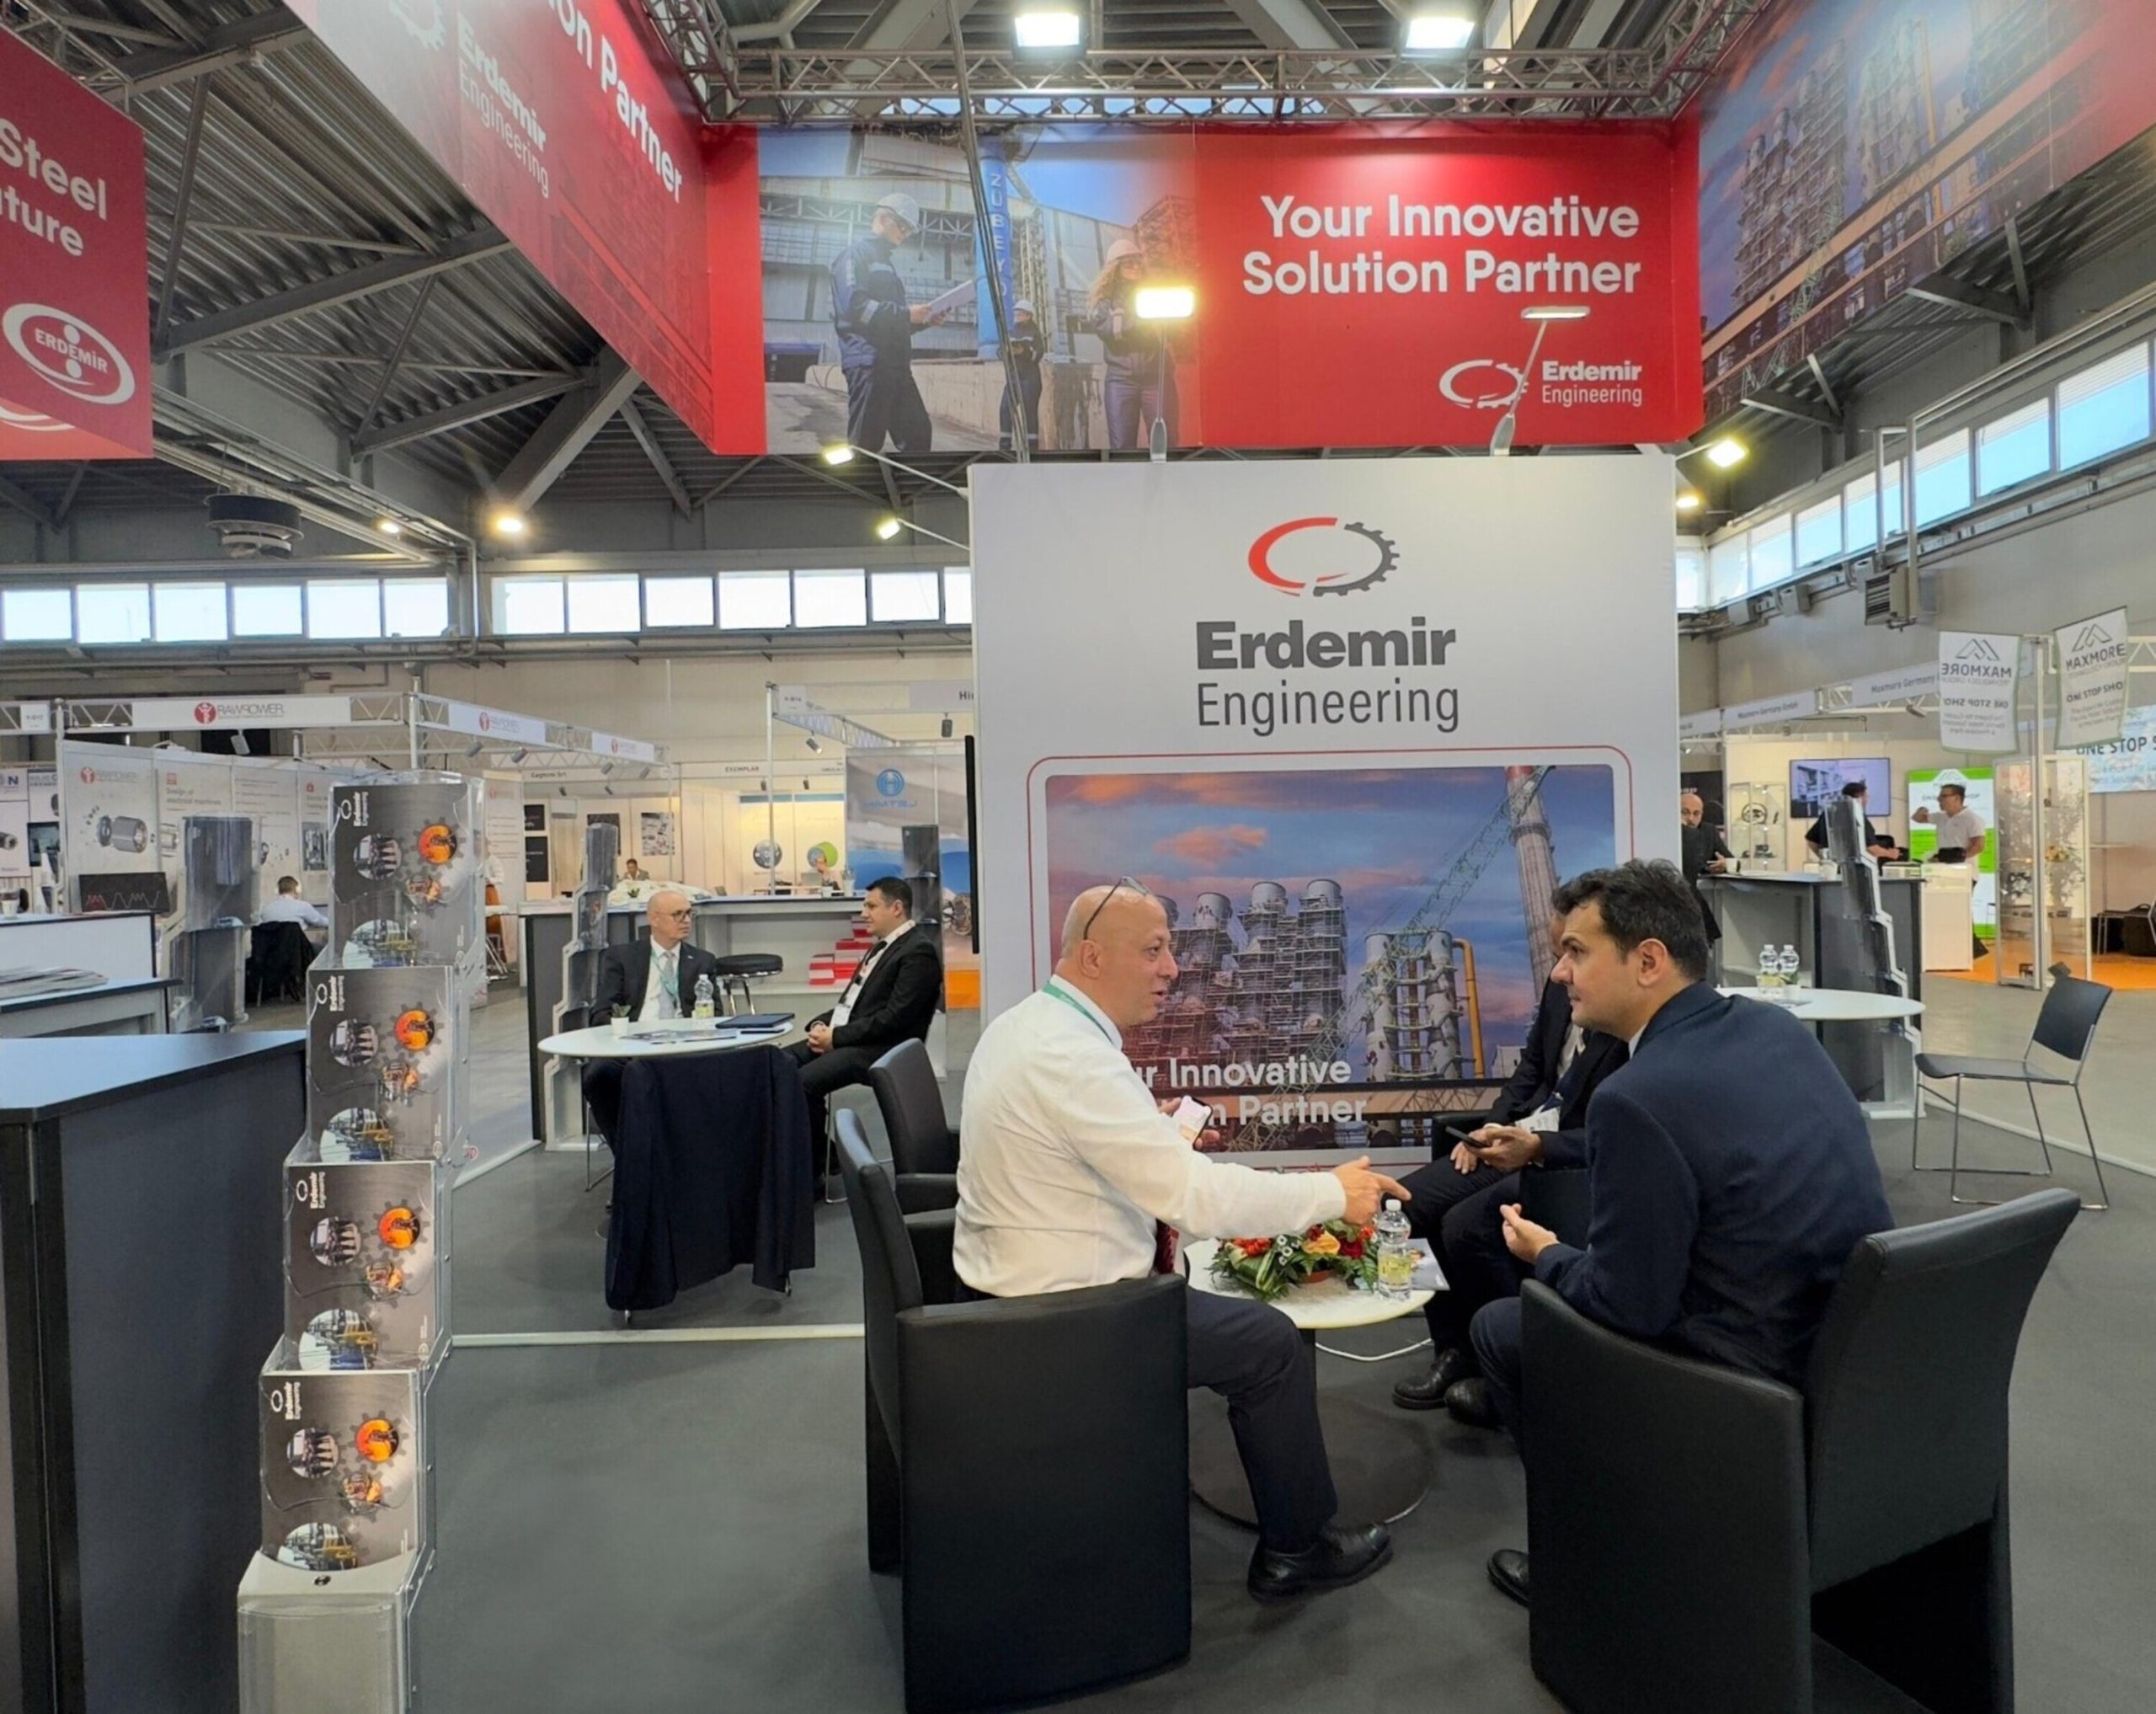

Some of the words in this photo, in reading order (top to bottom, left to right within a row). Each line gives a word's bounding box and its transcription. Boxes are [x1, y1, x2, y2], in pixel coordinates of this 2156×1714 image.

[457, 11, 547, 152] Erdemir
[458, 59, 549, 199] Engineering
[601, 35, 682, 204] Partner
[0, 118, 107, 221] Steel
[1261, 195, 1372, 238] Your
[1388, 194, 1640, 238] Innovative
[1243, 250, 1448, 295] Solution
[1465, 250, 1641, 293] Partner
[1542, 360, 1642, 382] Erdemir
[1542, 384, 1642, 407] Engineering
[1196, 616, 1456, 670] Erdemir
[2066, 643, 2127, 671] MAXMORE
[1197, 677, 1460, 737] Engineering
[2110, 737, 2147, 754] STOP
[1170, 1055, 1352, 1087] Innovative
[1239, 1096, 1368, 1126] Partner
